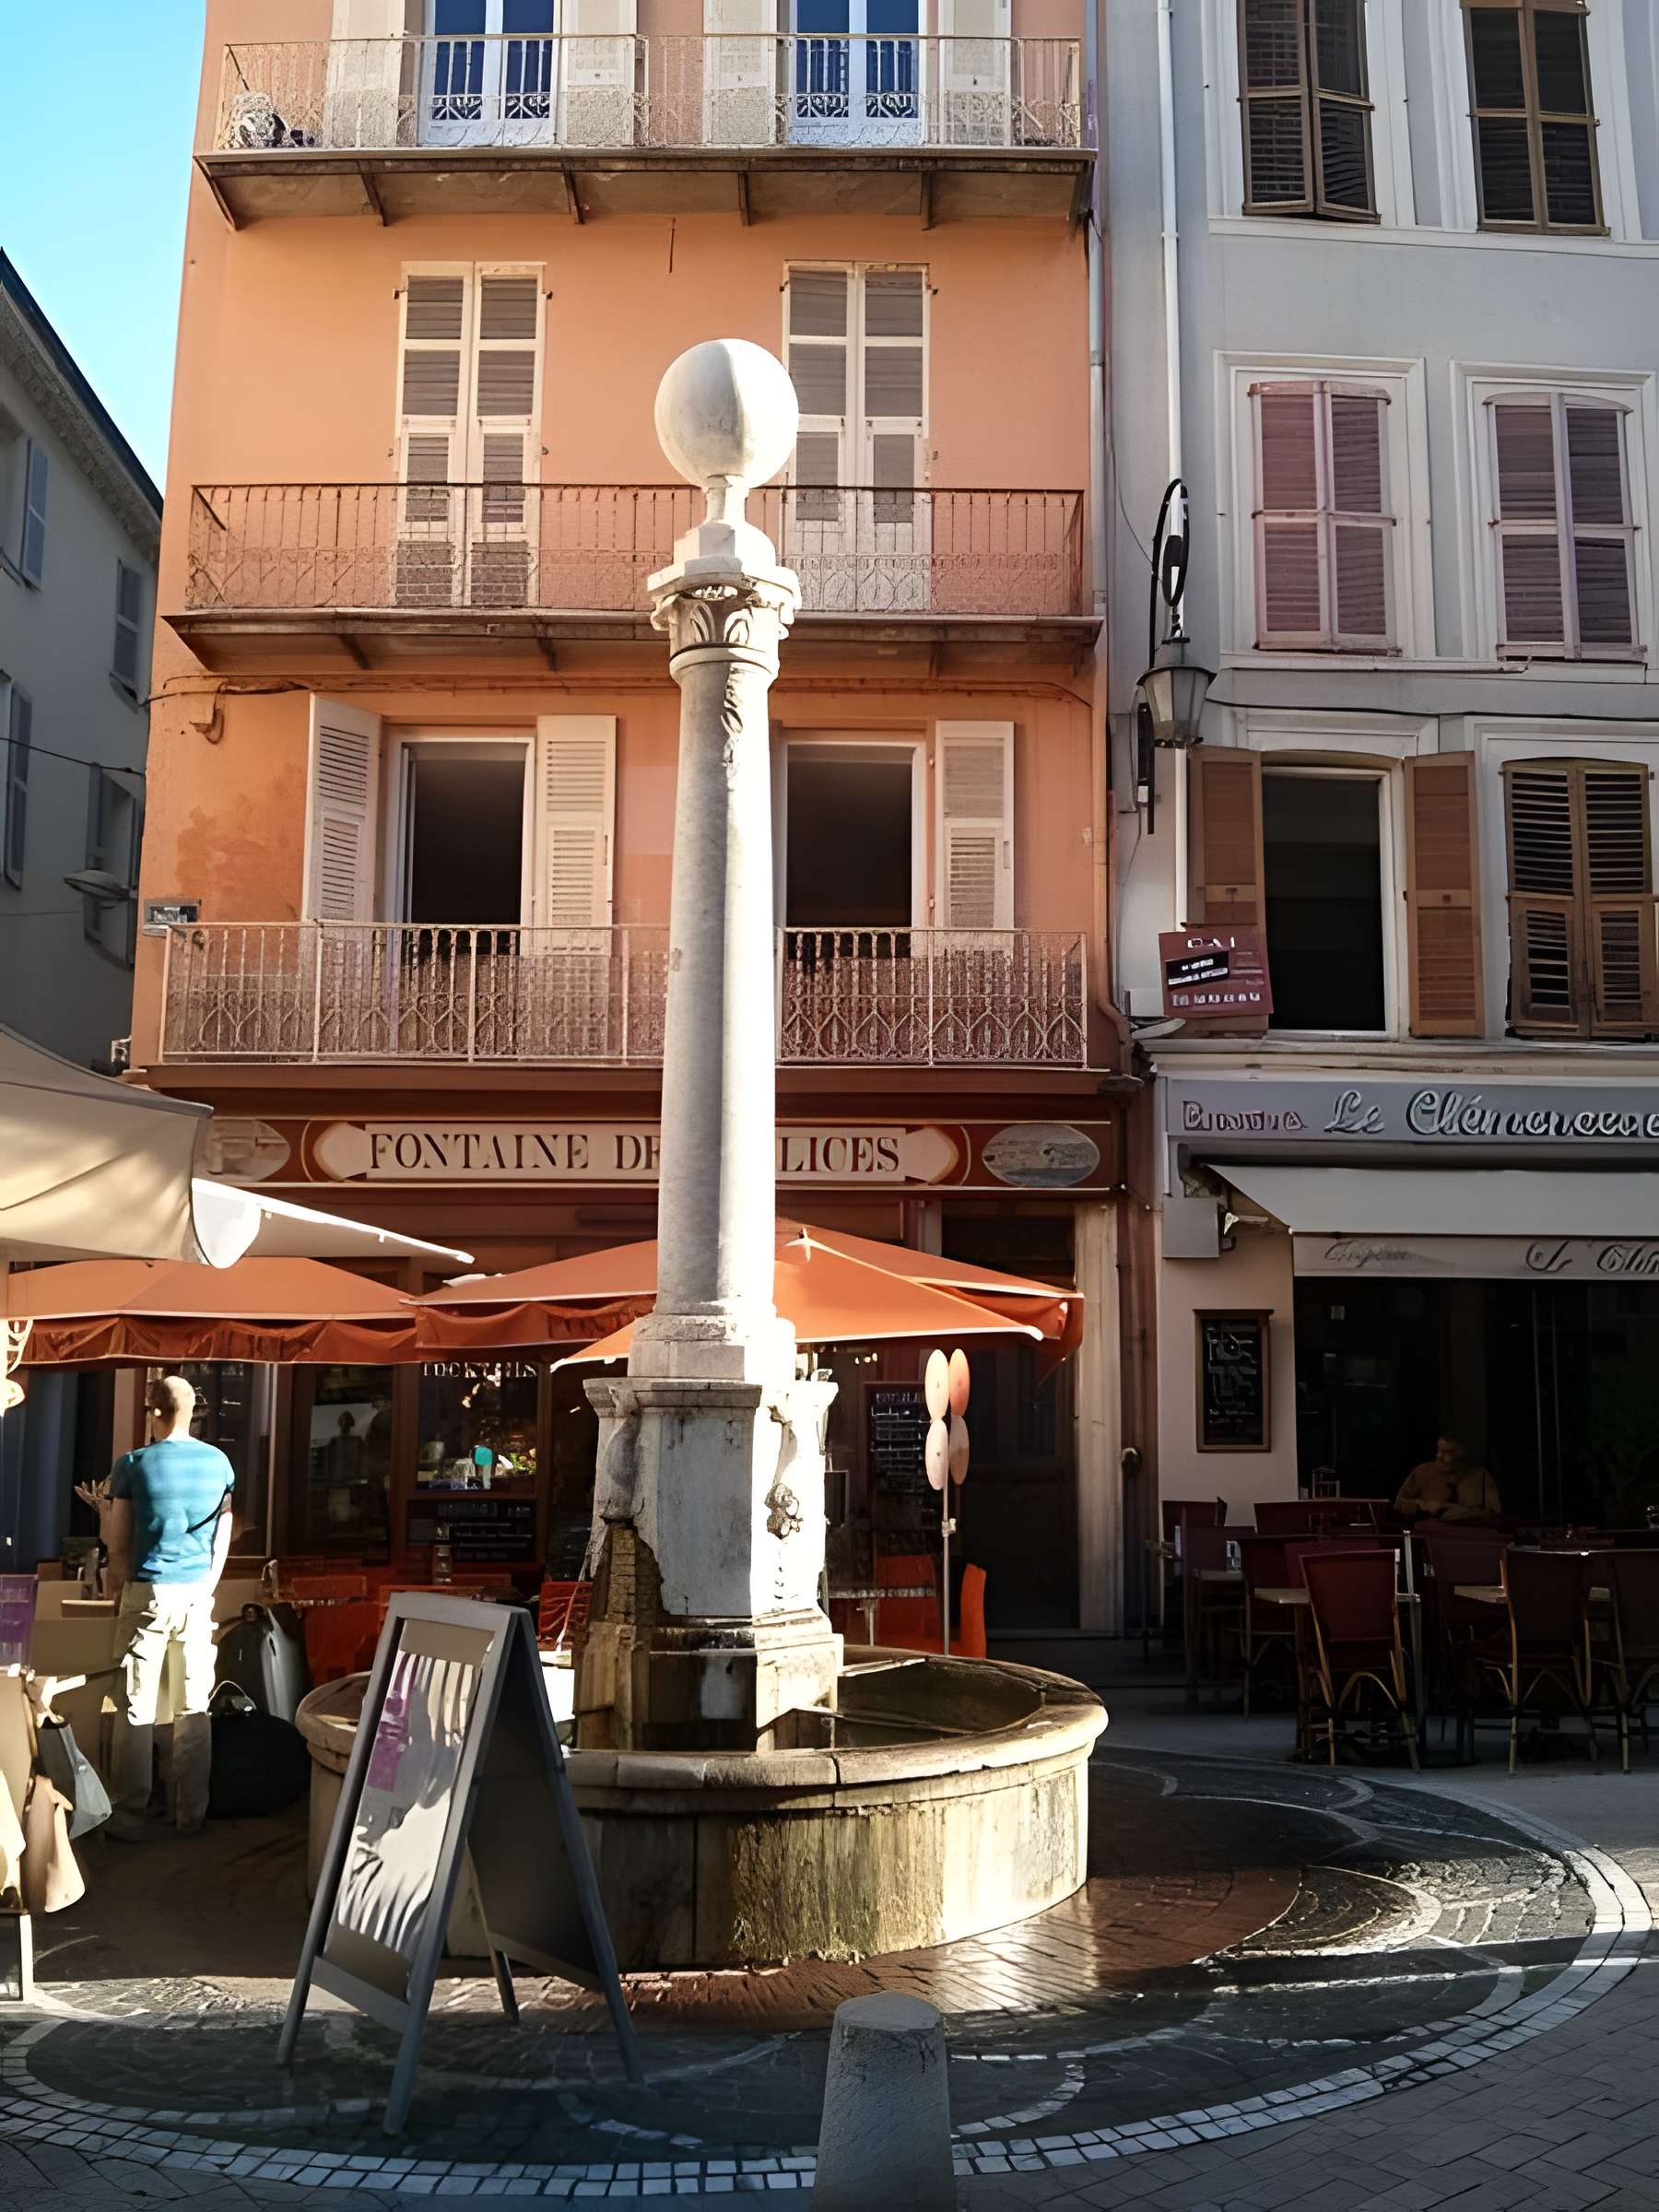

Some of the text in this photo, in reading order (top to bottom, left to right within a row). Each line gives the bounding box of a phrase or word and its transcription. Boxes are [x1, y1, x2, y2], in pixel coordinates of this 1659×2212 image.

[1324, 1089, 1385, 1135] Le
[371, 1134, 900, 1173] FONTAINE DE LICES
